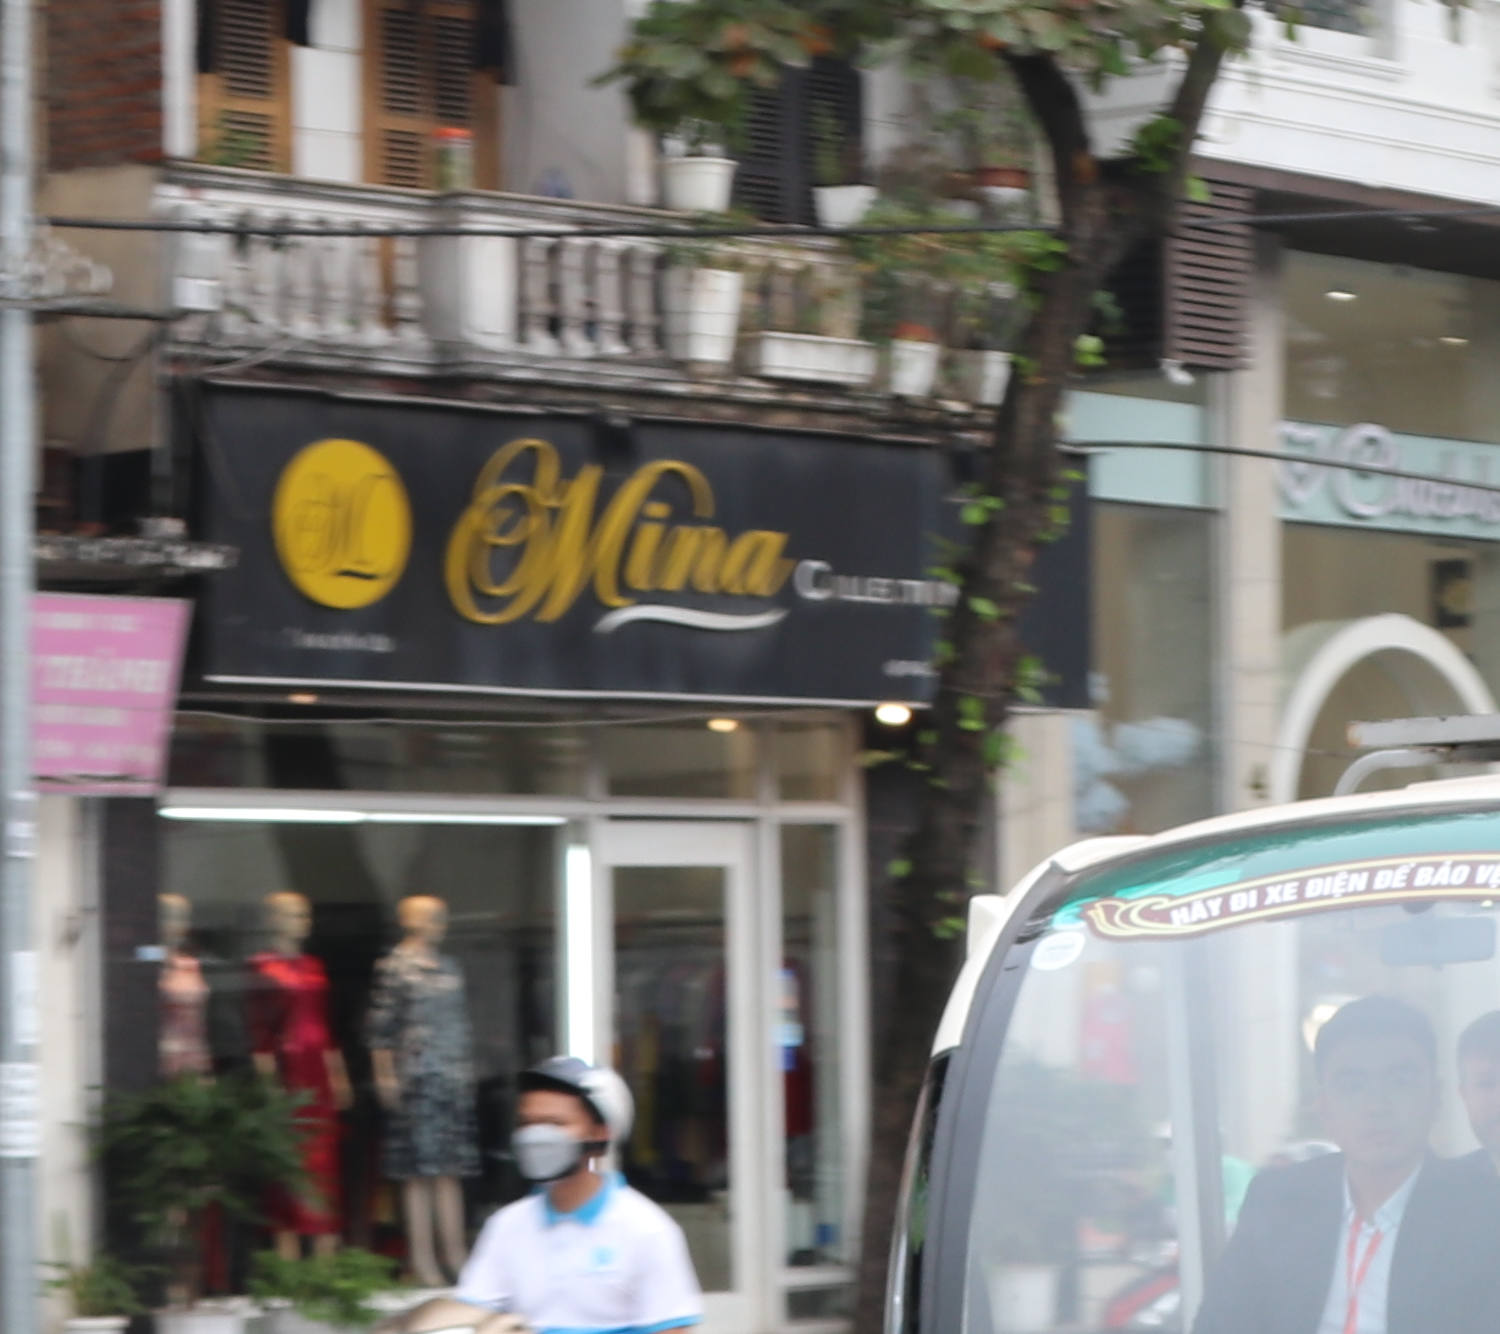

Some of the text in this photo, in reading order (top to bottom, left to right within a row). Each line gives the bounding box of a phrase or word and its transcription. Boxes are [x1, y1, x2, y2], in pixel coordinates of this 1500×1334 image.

[445, 439, 794, 624] Mina
[1229, 890, 1258, 913] ĐI
[1264, 880, 1301, 906] XE
[1305, 870, 1368, 899] ĐIỆN
[1373, 862, 1416, 890] ĐỂ
[1413, 860, 1471, 887] BẢO
